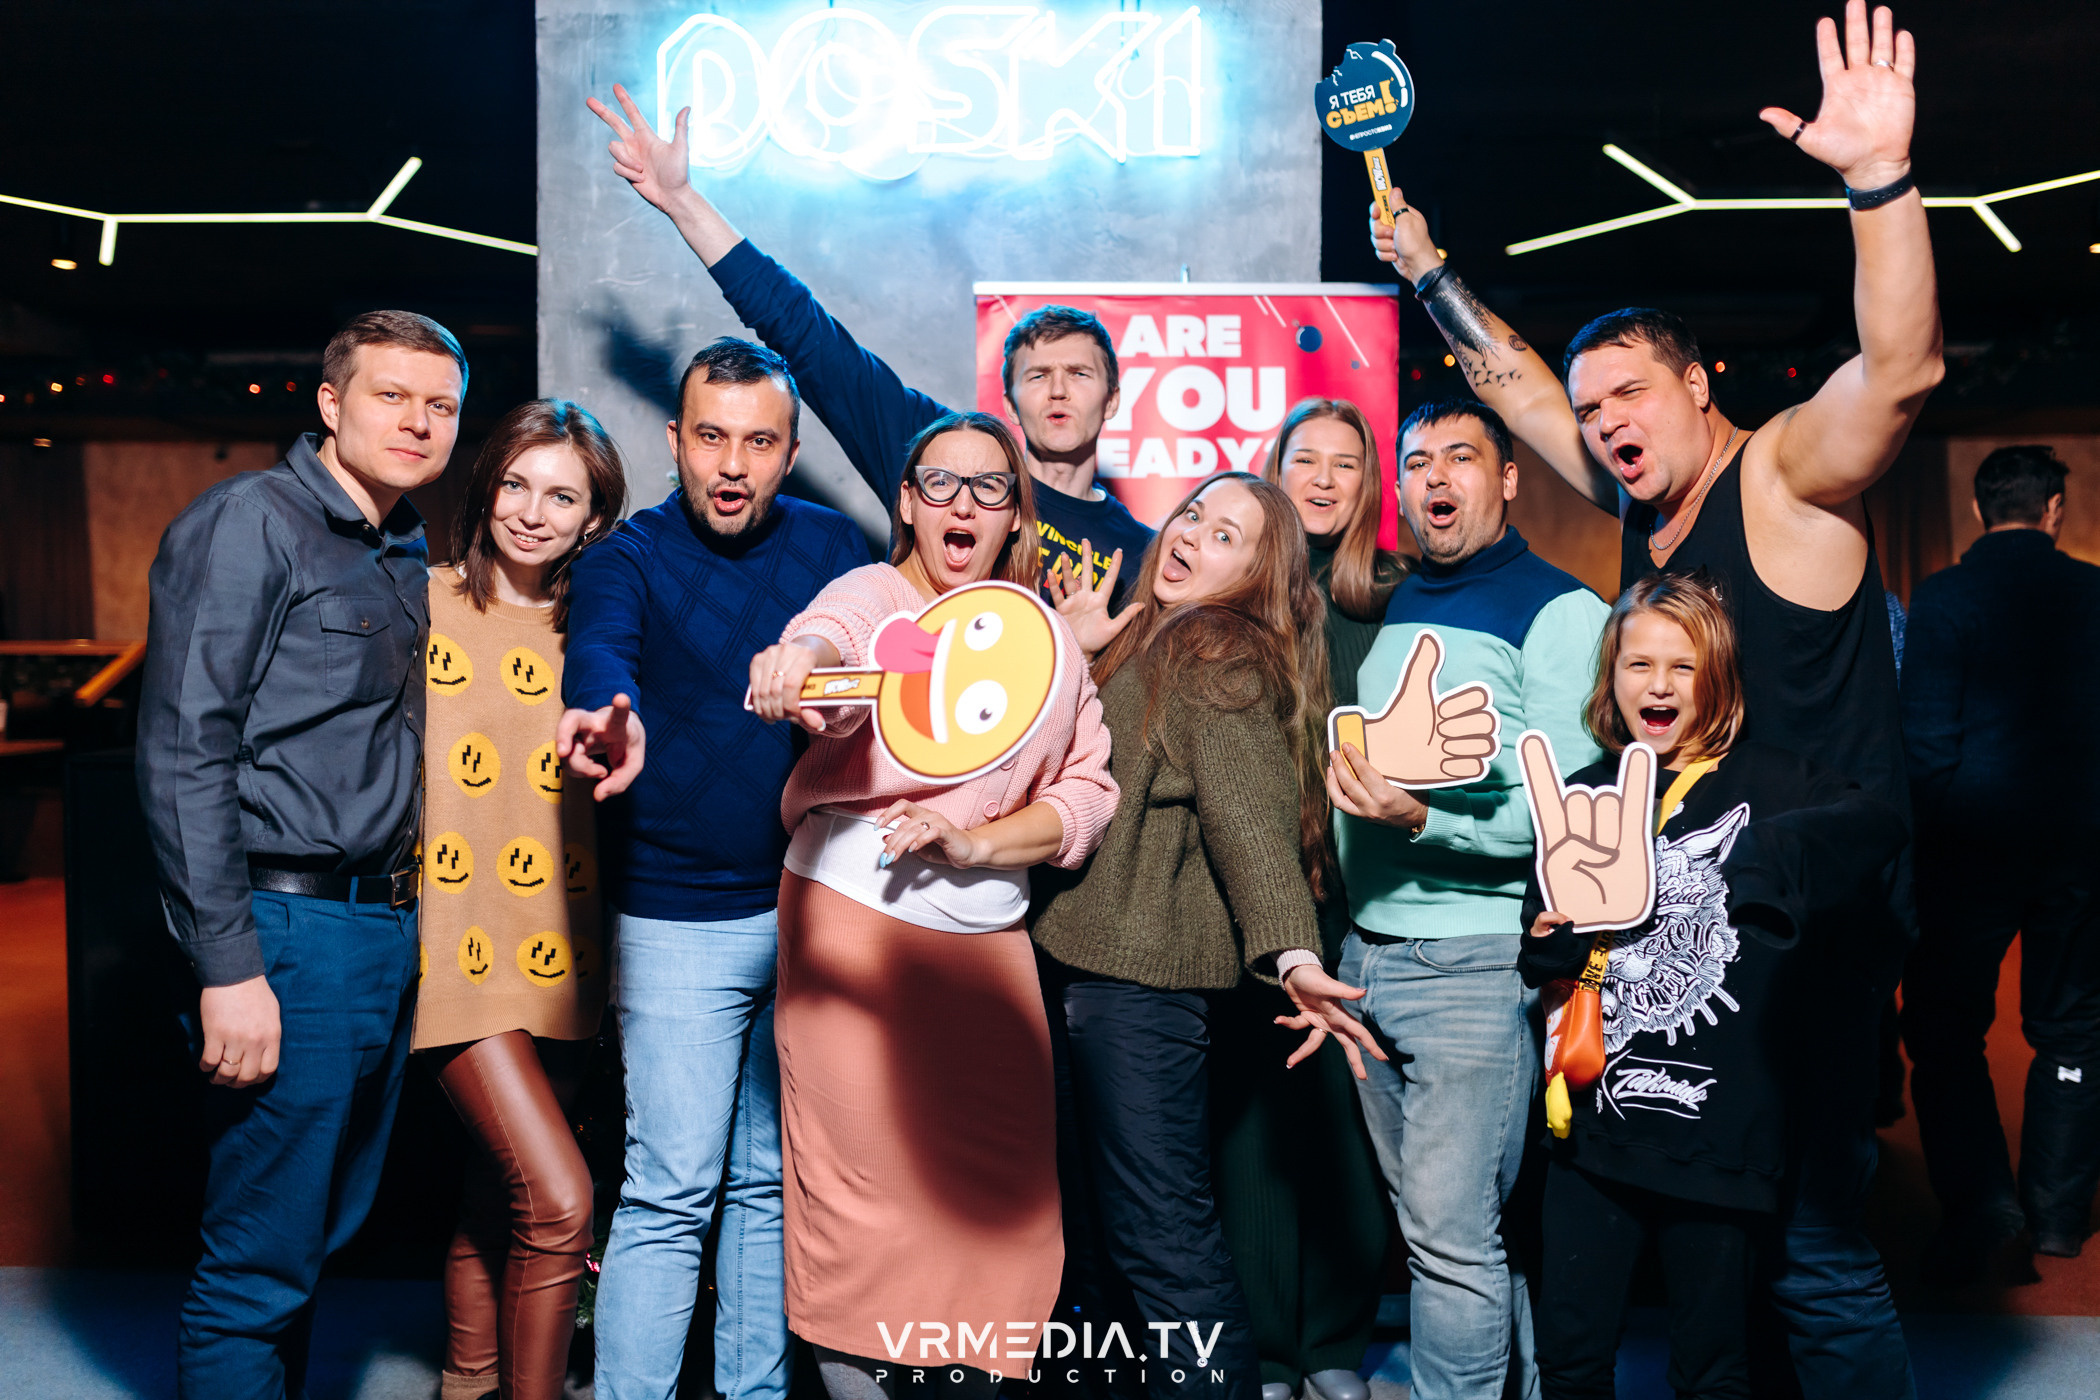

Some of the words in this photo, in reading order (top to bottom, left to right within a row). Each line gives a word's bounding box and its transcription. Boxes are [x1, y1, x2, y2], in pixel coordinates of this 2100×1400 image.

[1325, 78, 1398, 129] СЪЕМ!
[1328, 94, 1340, 110] Я
[1339, 84, 1376, 106] ТЕБЯ
[1116, 314, 1242, 358] ARE
[1105, 364, 1287, 432] YOU
[1097, 436, 1276, 479] EADY
